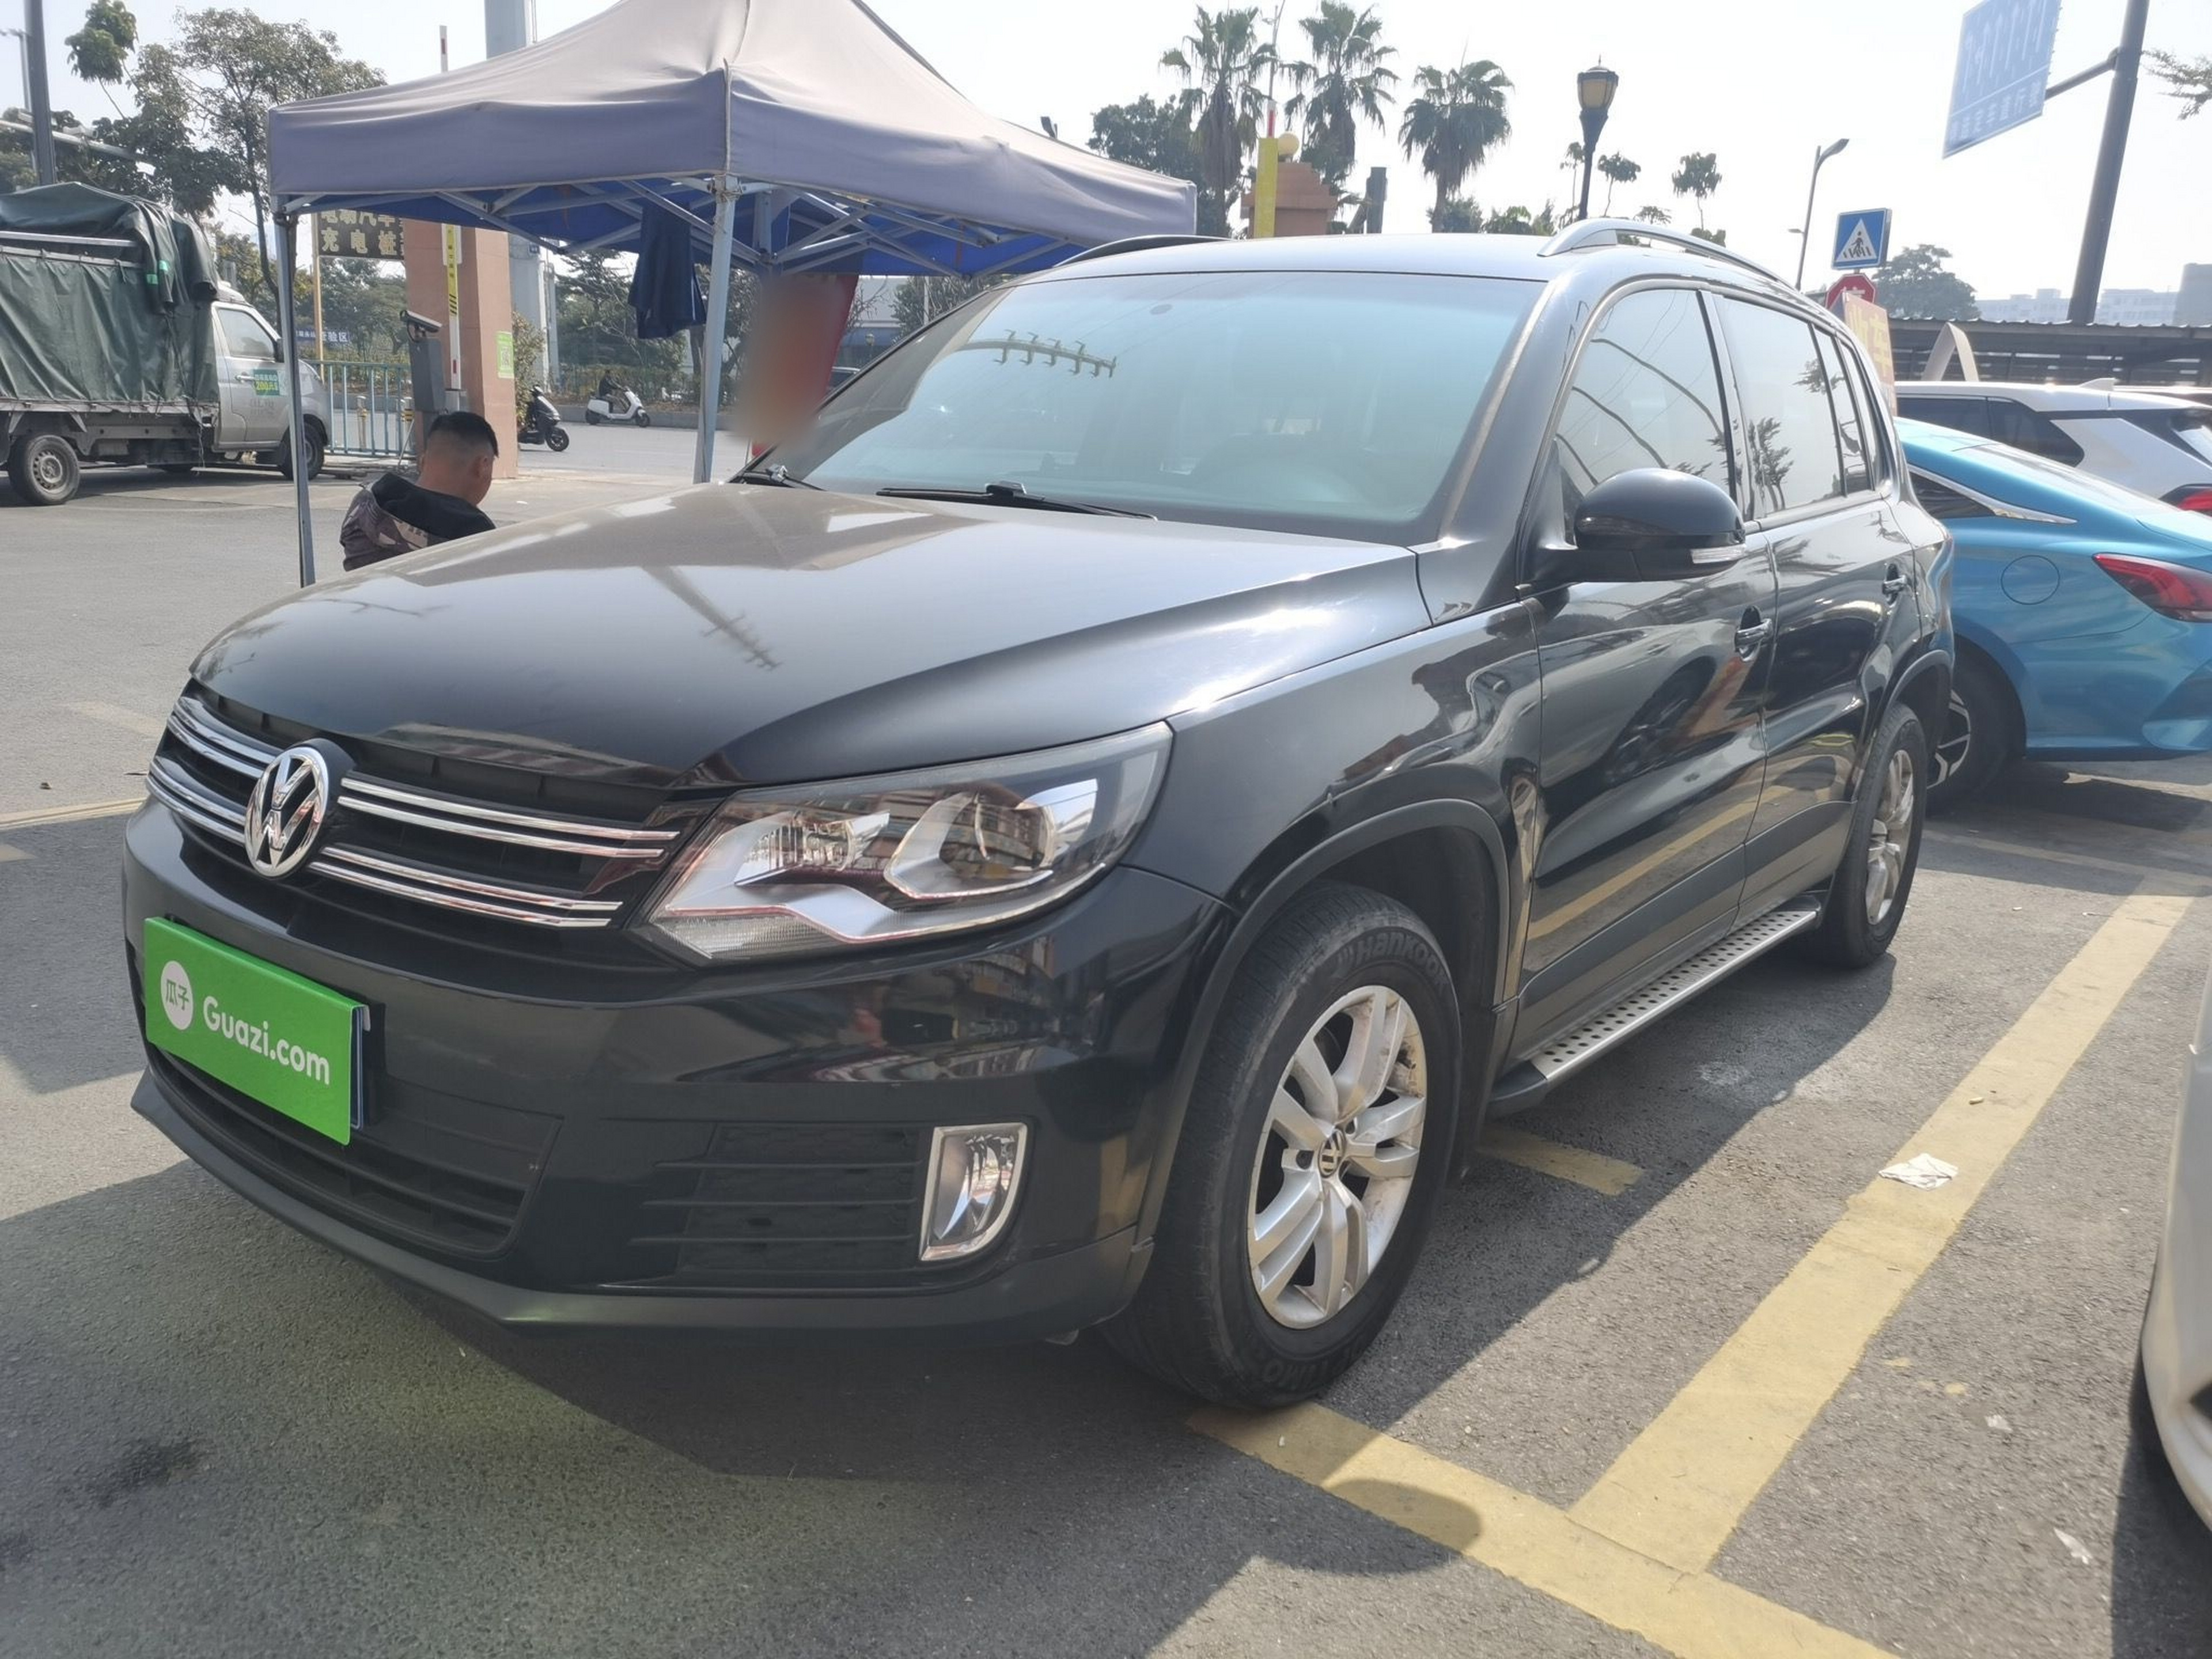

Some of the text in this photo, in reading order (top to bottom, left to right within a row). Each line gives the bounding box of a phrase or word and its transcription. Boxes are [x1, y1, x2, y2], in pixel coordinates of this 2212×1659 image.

[321, 227, 397, 255] 充电桩
[164, 979, 330, 1086] 瓜子 Guazi.com
